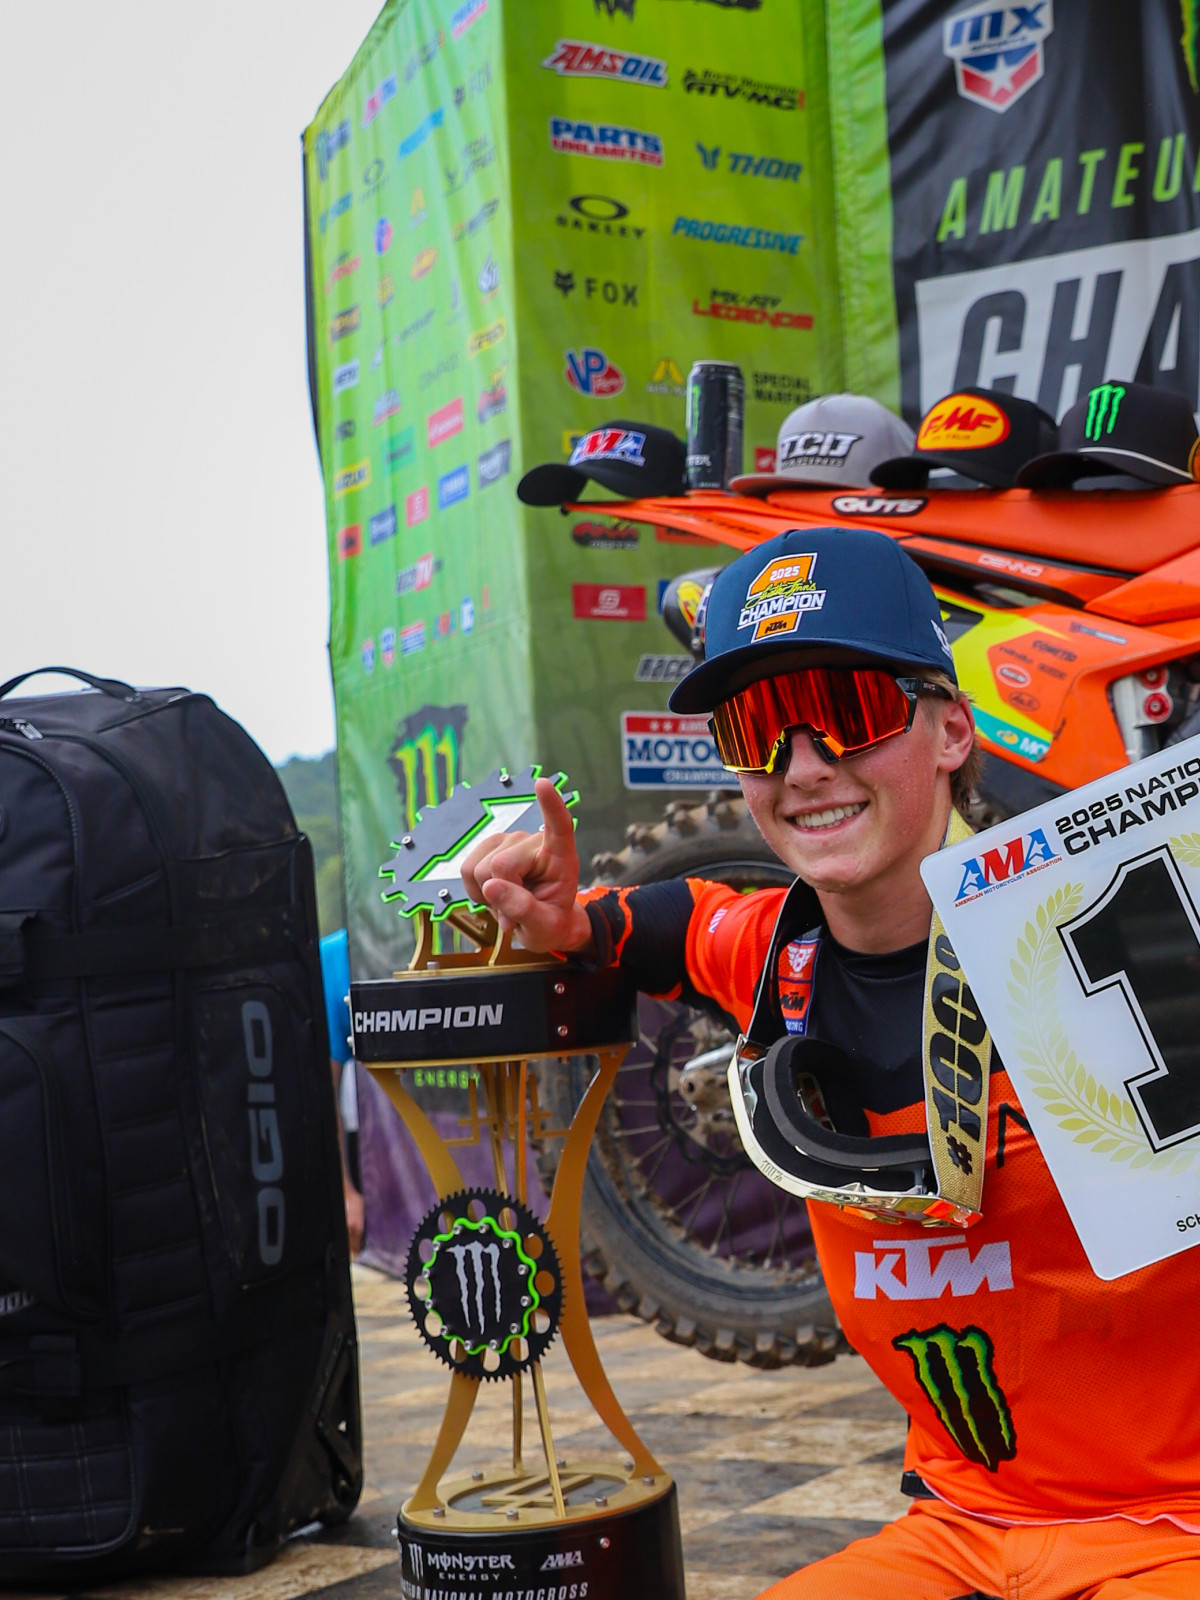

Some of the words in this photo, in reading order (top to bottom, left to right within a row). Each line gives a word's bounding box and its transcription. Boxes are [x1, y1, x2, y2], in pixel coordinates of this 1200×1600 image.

[548, 42, 667, 86] AMSOIL
[550, 117, 661, 152] PARTS
[551, 138, 663, 168] UNLIMITED
[727, 151, 803, 182] THOR
[555, 215, 646, 240] OAKLEY
[672, 215, 805, 256] PROGRESSIVE
[585, 276, 639, 308] FOX
[565, 349, 607, 395] VP
[922, 406, 999, 441] FMF
[833, 496, 924, 515] GUTS
[769, 565, 801, 583] 2025
[738, 592, 827, 627] CHAMPION
[1055, 793, 1124, 835] 2025
[953, 828, 1061, 903] AMA
[954, 891, 984, 909] AMERICAN
[1025, 856, 1063, 877] ASSOCIATION
[354, 1003, 504, 1034] CHAMPION
[413, 1069, 482, 1089] ENERGY
[241, 1000, 286, 1266] OGIO
[853, 1234, 1015, 1301] KTM
[438, 1572, 501, 1582] ENERGY
